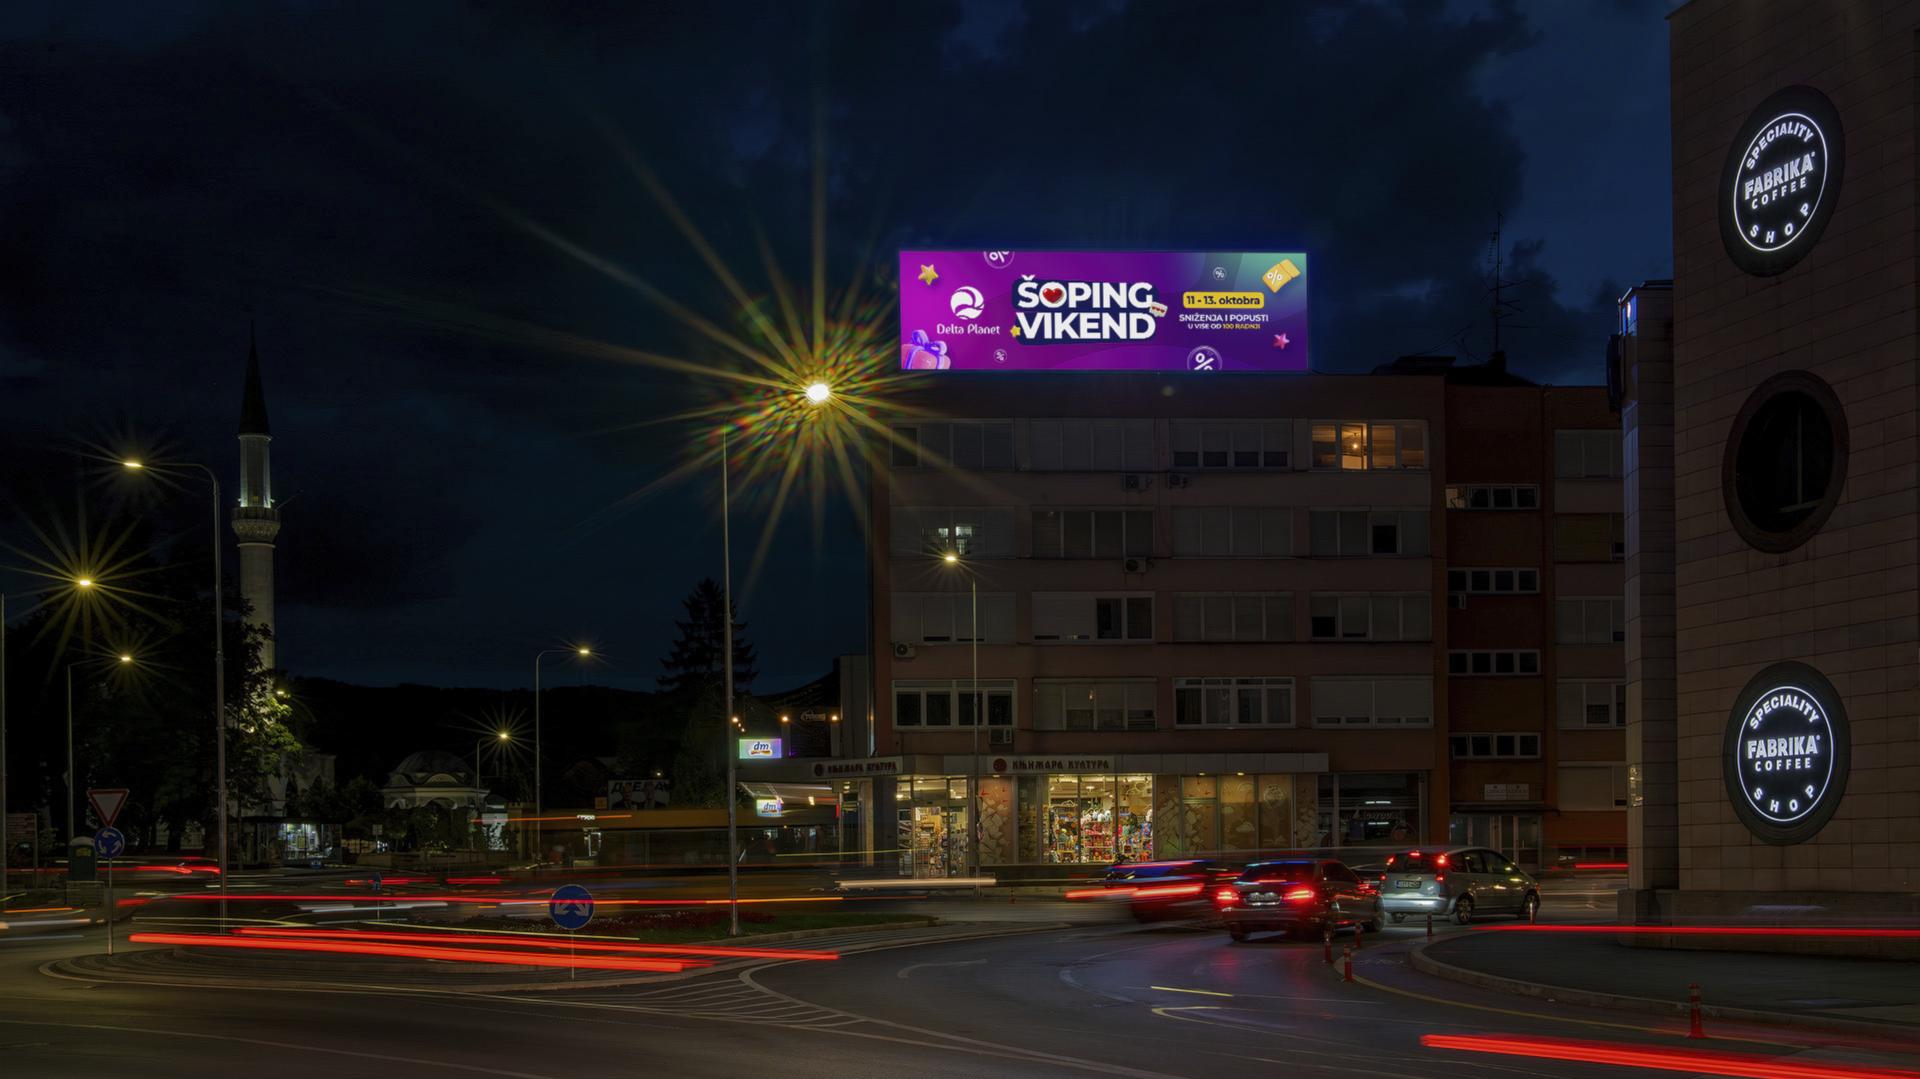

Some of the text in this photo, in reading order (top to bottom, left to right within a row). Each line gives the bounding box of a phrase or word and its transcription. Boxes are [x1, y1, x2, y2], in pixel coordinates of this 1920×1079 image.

[1746, 121, 1814, 171] SPECIALITY
[1744, 153, 1814, 201] FABRIKA
[1751, 177, 1807, 210] COFFEE
[1750, 202, 1810, 244] SHOP
[1017, 274, 1154, 309] ŠOPING
[1187, 296, 1195, 305] 11
[1204, 296, 1217, 305] 13.
[1219, 295, 1261, 305] oktobra
[936, 323, 1000, 335] Delta Planet
[1017, 312, 1156, 340] VIKEND
[1179, 312, 1223, 322] SNIŽENJA
[1230, 314, 1269, 322] POPUSTI
[1749, 694, 1820, 730] SPECIALITY
[753, 741, 769, 751] dm
[1746, 735, 1819, 760] FABRIKA
[1754, 757, 1812, 772] COFFEE
[1753, 784, 1816, 813] SHOP
